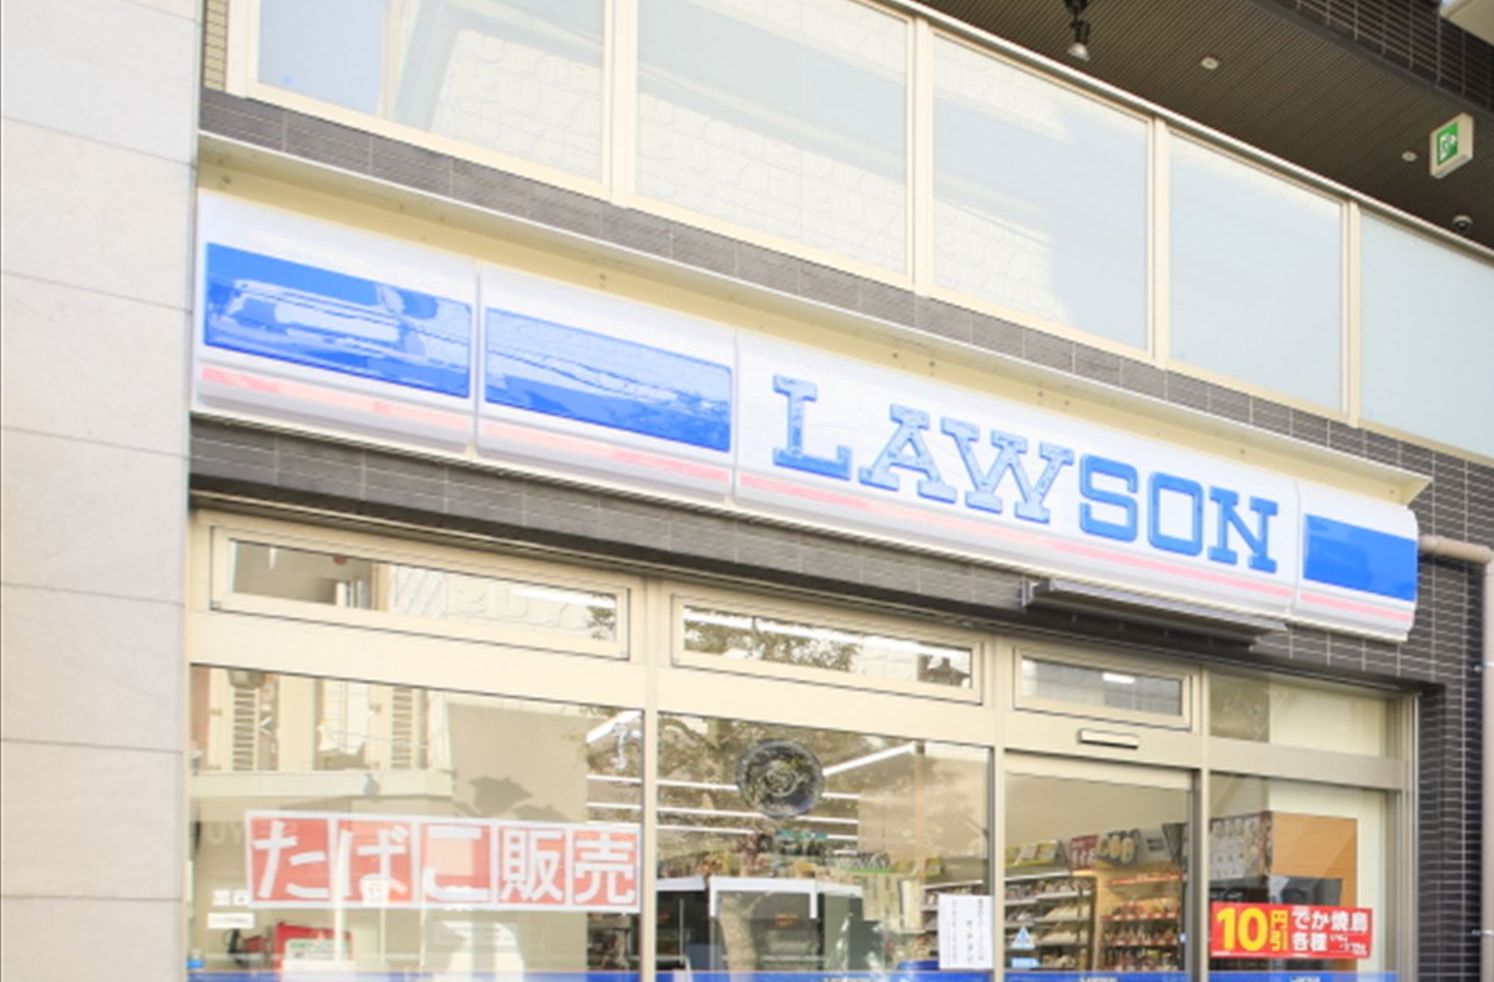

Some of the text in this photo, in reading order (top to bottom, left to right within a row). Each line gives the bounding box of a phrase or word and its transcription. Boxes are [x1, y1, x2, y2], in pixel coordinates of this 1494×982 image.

[771, 373, 1279, 574] LAWSON
[252, 818, 637, 905] たばこ販売
[1291, 932, 1327, 951] 各種
